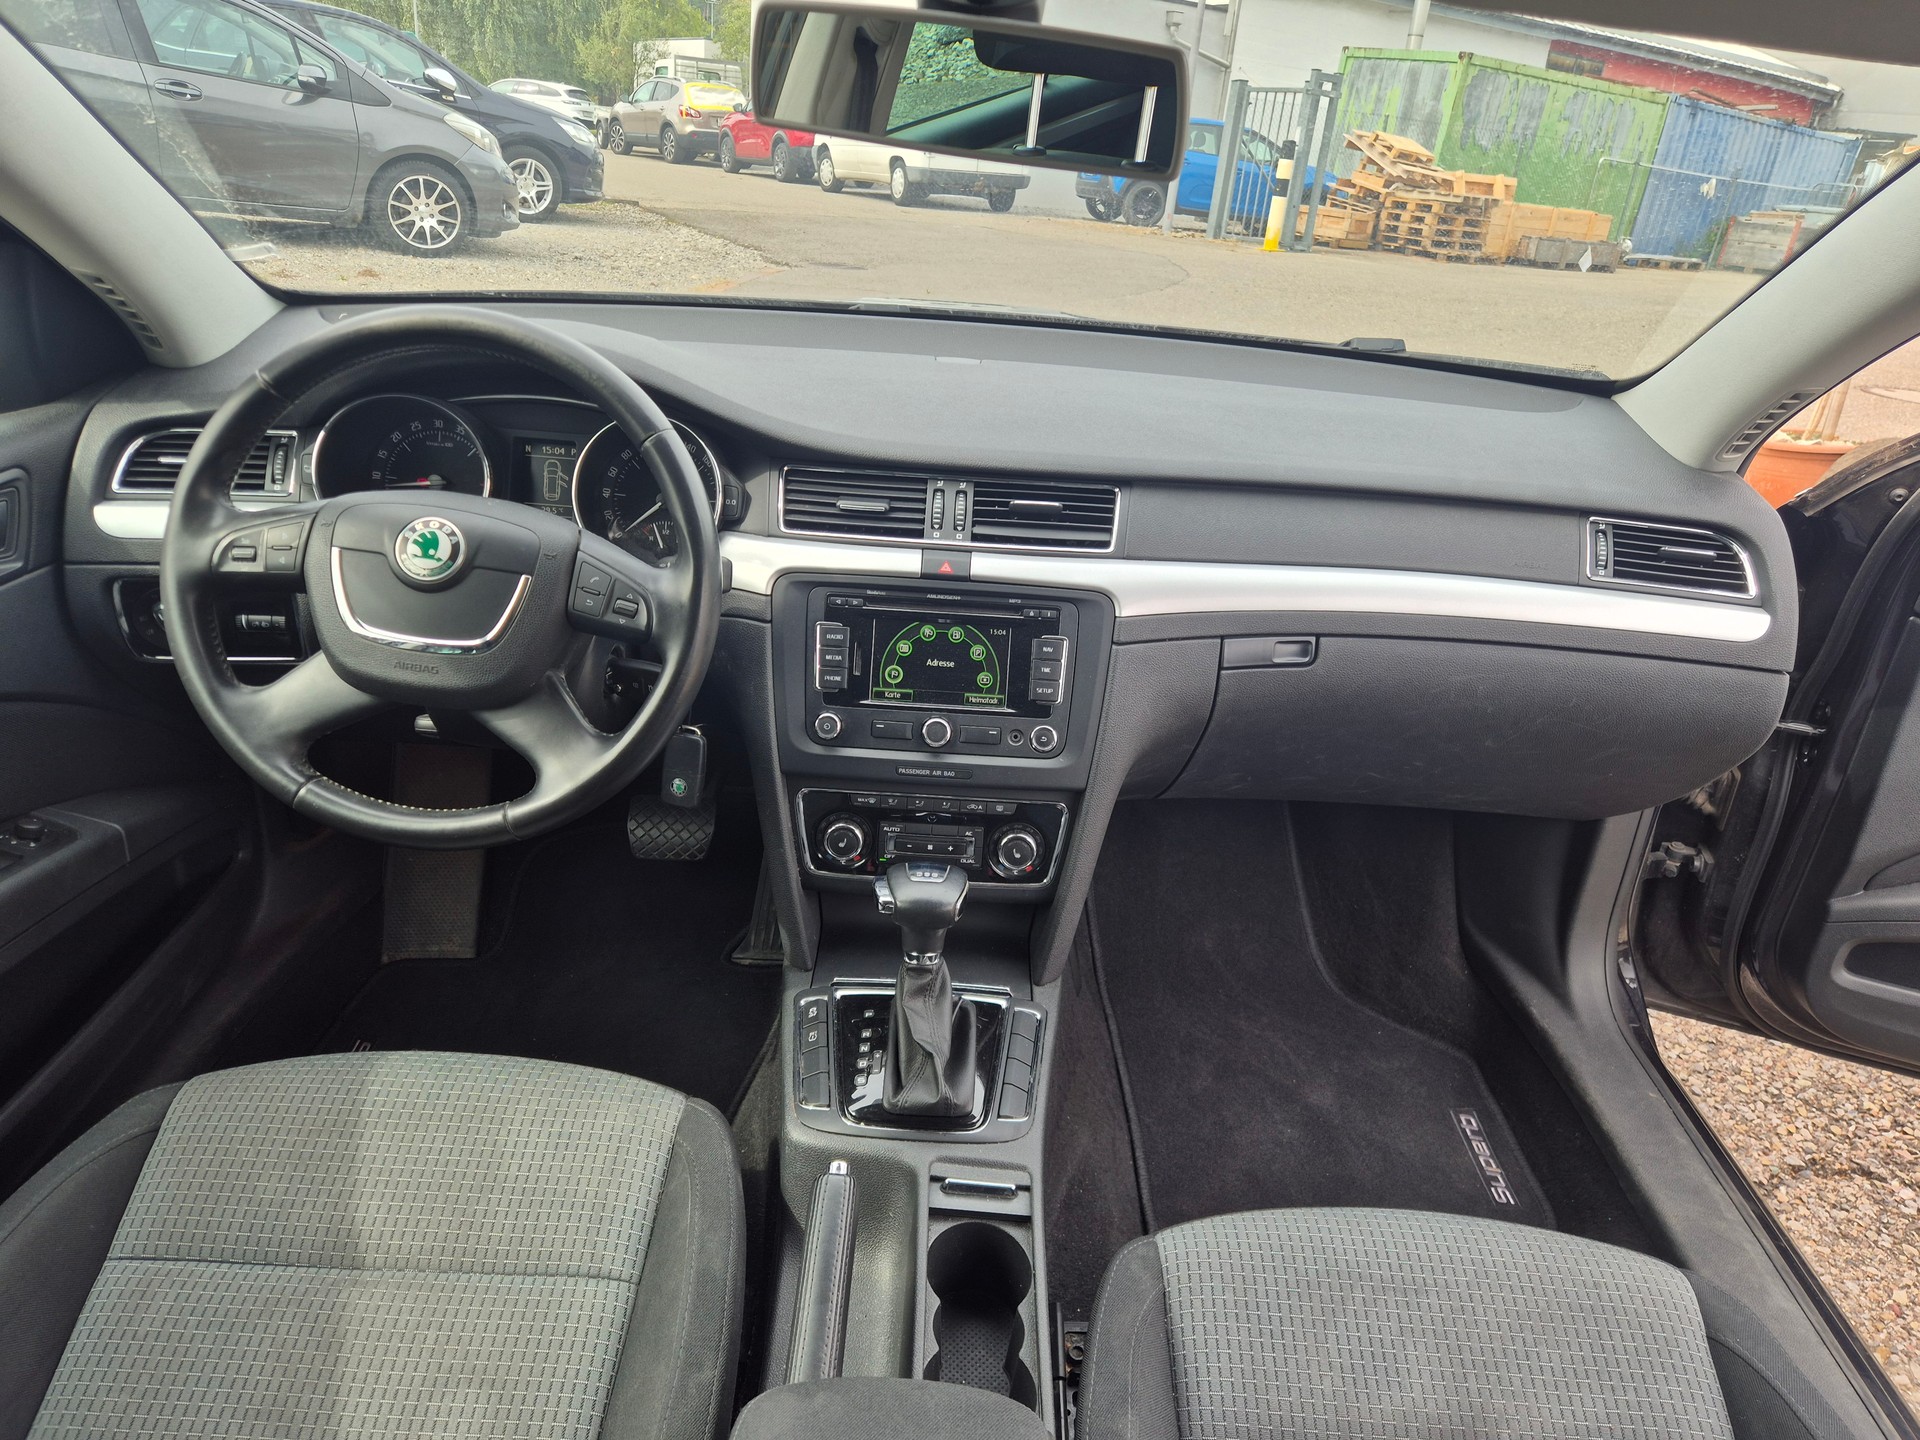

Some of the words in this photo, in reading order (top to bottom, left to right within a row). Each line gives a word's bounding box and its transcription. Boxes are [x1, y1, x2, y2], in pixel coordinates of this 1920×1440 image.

[410, 421, 422, 432] 25
[433, 420, 444, 428] 30
[456, 424, 465, 436] 35
[390, 431, 402, 443] 20
[378, 449, 388, 459] 15
[542, 446, 565, 455] 15:04
[621, 449, 632, 460] 80
[372, 471, 381, 480] 10
[608, 466, 618, 478] 60
[602, 488, 611, 498] 40
[604, 510, 614, 520] 20
[990, 628, 1006, 636] 15:04
[825, 654, 842, 662] MEDIA
[393, 661, 439, 674] AIRBAG
[926, 659, 955, 668] Adresse
[884, 691, 901, 699] Karte
[1459, 1113, 1515, 1205] Superb
